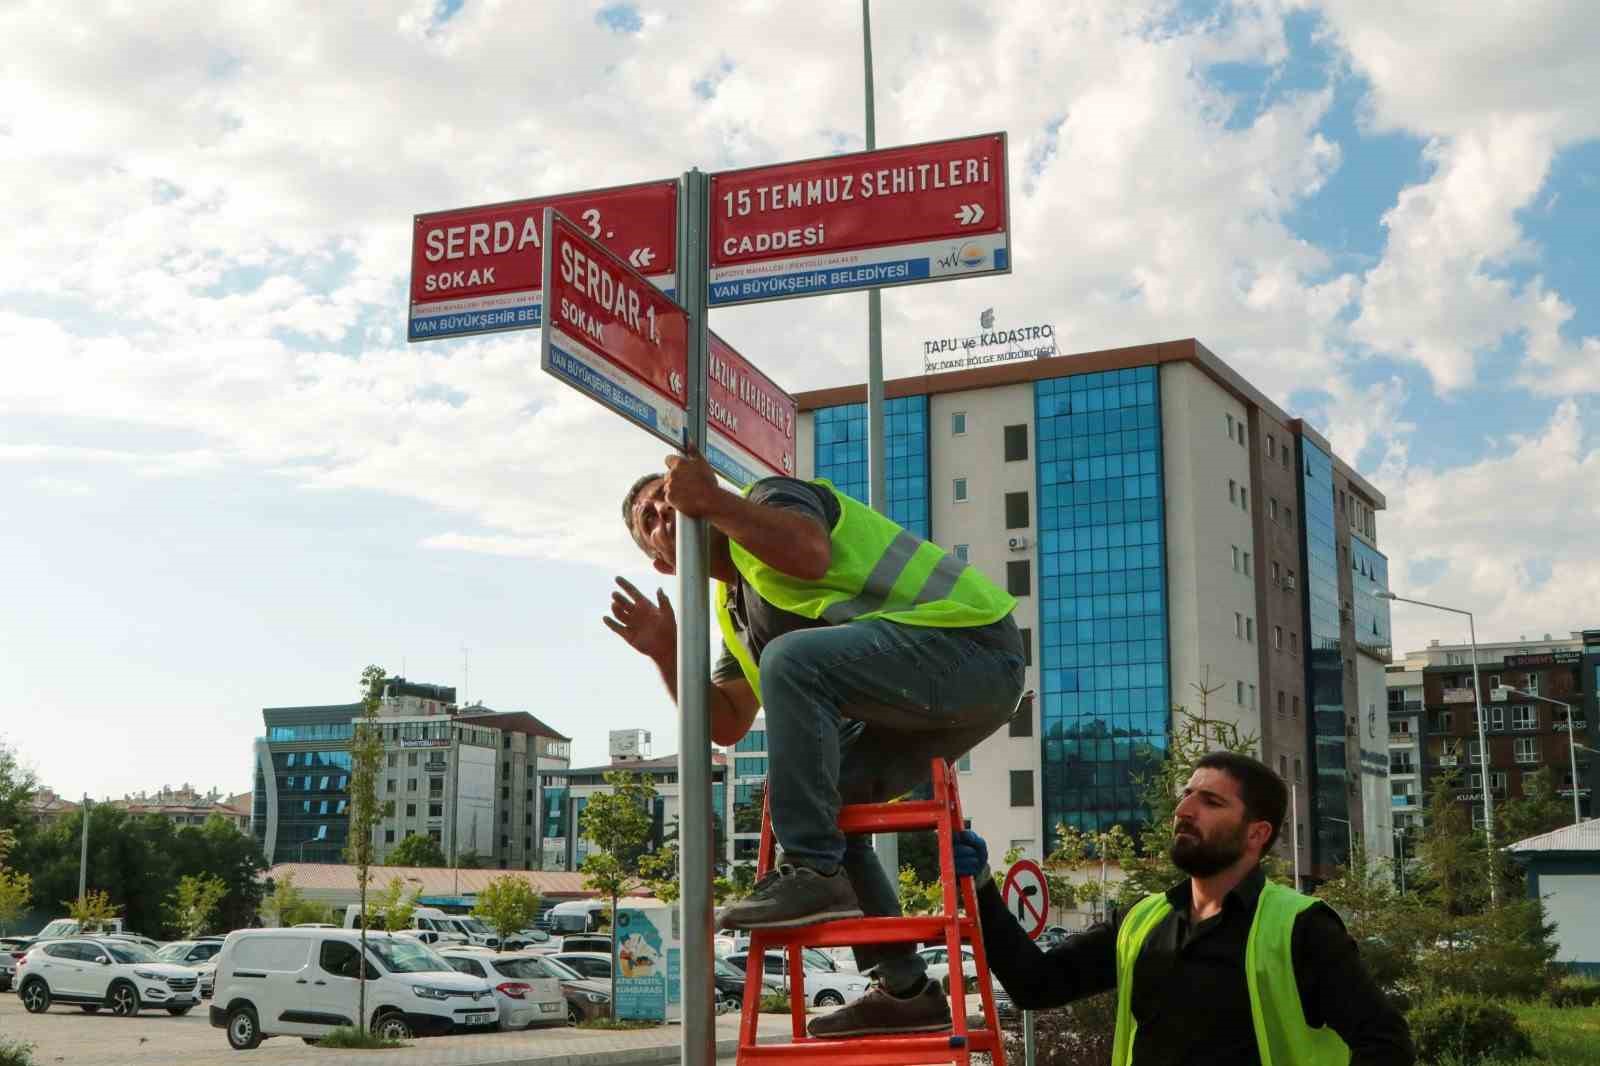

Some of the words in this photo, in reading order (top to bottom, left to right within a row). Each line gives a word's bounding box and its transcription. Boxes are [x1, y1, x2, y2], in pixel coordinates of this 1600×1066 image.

[723, 188, 751, 219] 15
[757, 175, 854, 212] TEMMUZ
[425, 216, 543, 263] SERDA
[581, 208, 616, 240] 3.
[723, 223, 825, 256] CADDESİ
[425, 266, 495, 292] SOKAK
[560, 240, 641, 332] SERDAR
[646, 304, 661, 346] 1.
[713, 284, 739, 299] VAN
[743, 273, 827, 295] BÜYÜKŞEHİR
[831, 262, 909, 285] BELEDİYESİ
[413, 319, 437, 333] VAN
[439, 309, 516, 330] BÜYÜKŞEHİR
[560, 297, 606, 346] SOKAK
[924, 338, 957, 355] TAPU
[961, 338, 976, 349] ve
[980, 324, 1053, 347] KADASTRO
[551, 349, 567, 370] VAN
[708, 351, 737, 396] KAZIM
[708, 398, 738, 433] SOKAK
